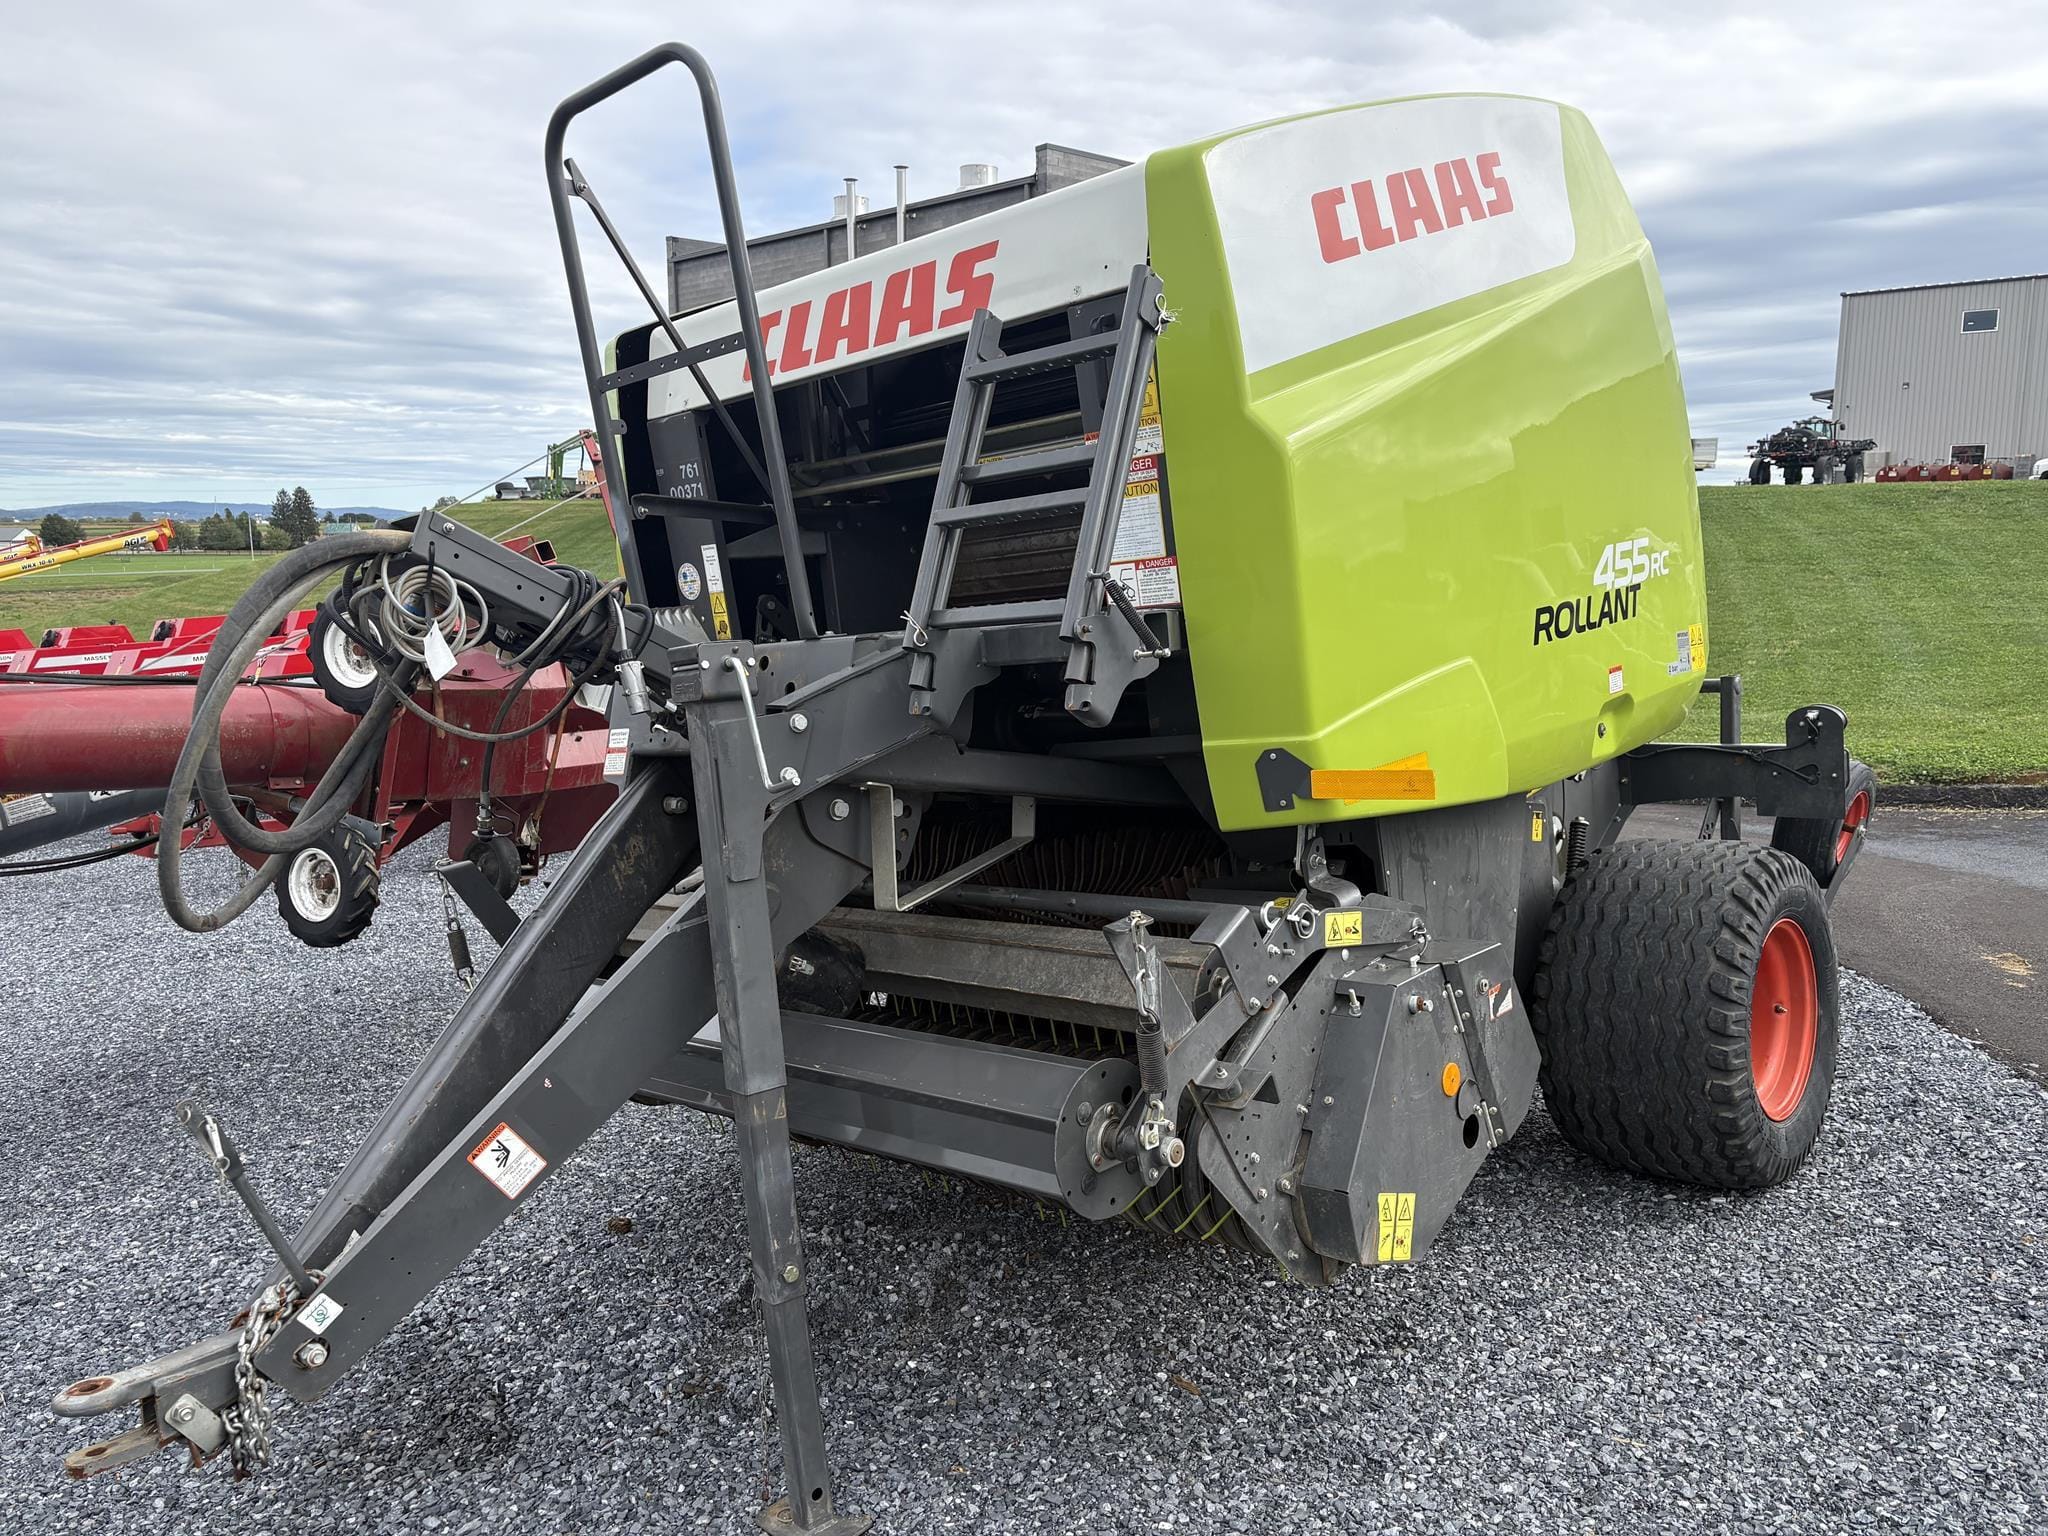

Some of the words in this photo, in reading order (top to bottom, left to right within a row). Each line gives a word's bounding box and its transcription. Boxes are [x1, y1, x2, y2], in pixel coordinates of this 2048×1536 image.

[1311, 151, 1514, 264] CLAAS
[743, 239, 1000, 382] CLAAS
[1140, 416, 1158, 427] TION
[679, 462, 699, 479] 761
[670, 482, 704, 498] 00371
[1124, 482, 1158, 498] UTION
[1145, 558, 1173, 568] DANGER
[1534, 583, 1641, 646] ROLLANT
[475, 1124, 505, 1153] WARNING
